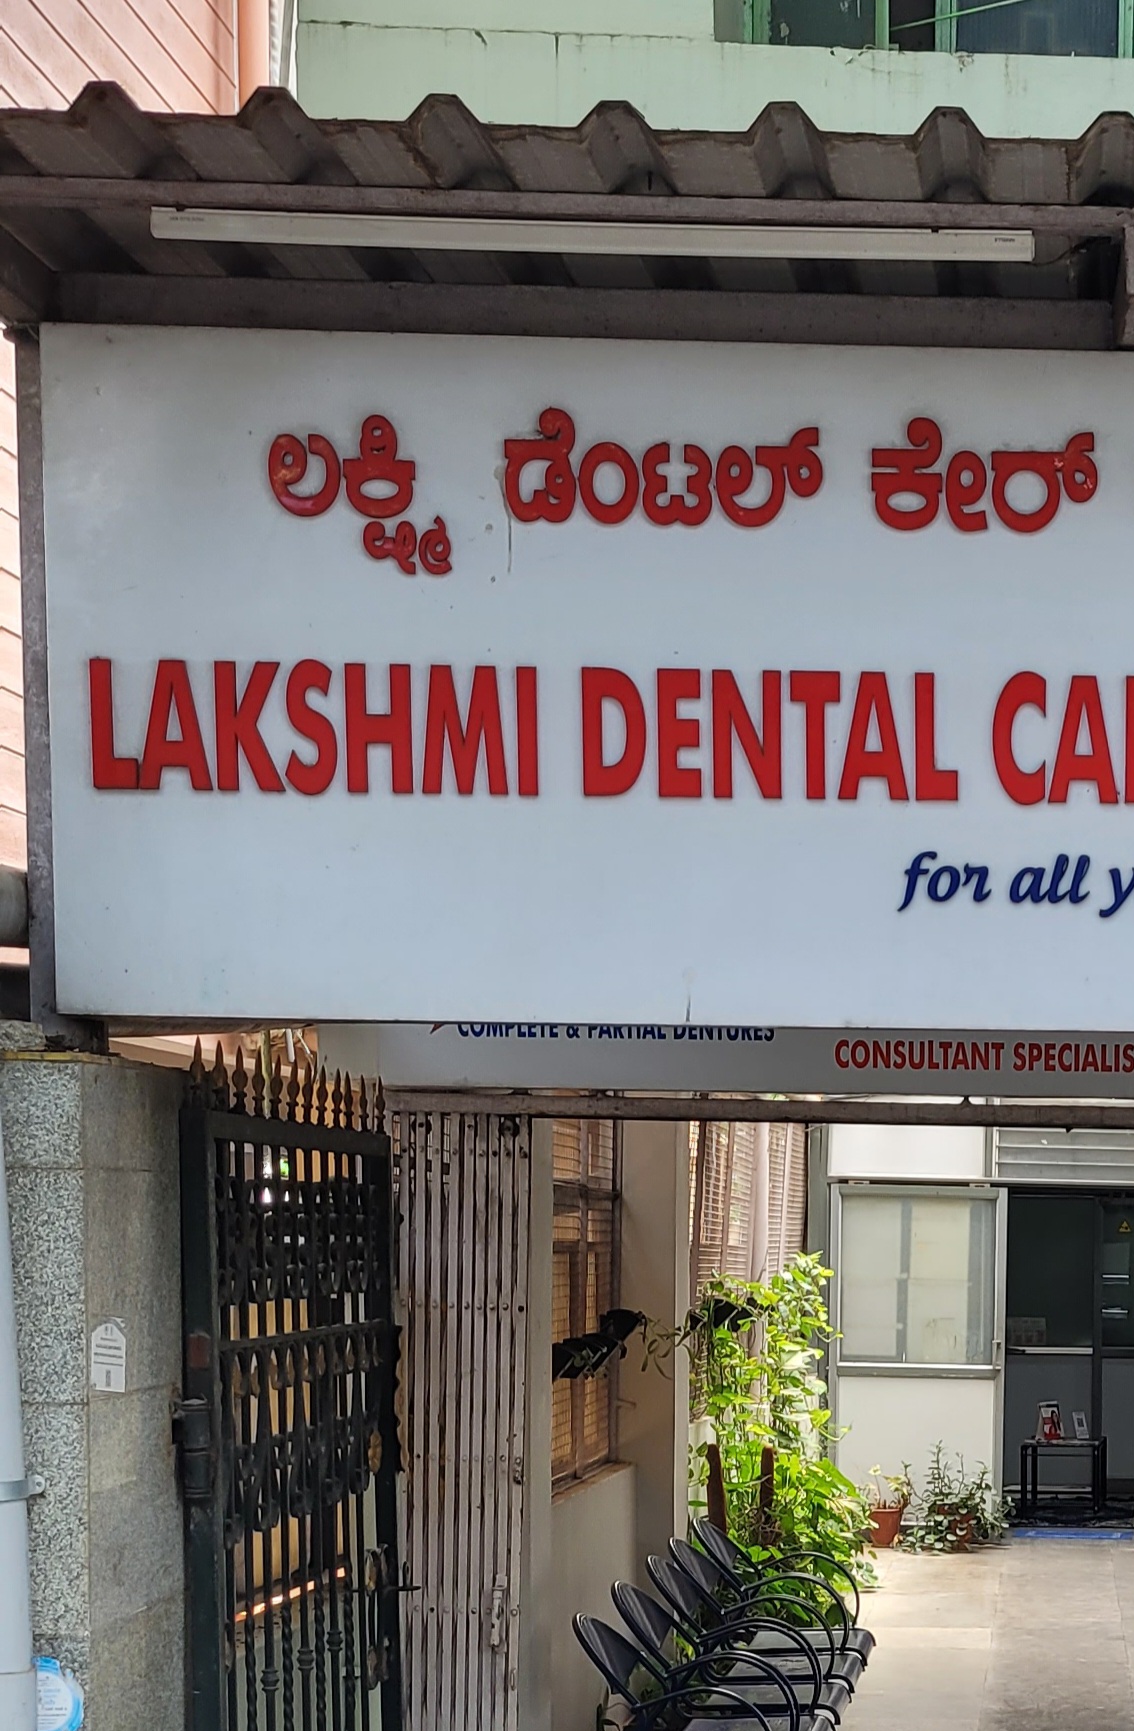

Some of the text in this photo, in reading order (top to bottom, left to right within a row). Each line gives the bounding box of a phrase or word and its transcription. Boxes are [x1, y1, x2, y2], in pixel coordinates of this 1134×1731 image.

[503, 408, 823, 527] ಡೆಂಟಲ್
[871, 418, 1098, 533] ಕೇರ್
[88, 656, 539, 797] LAKSHMI
[581, 666, 959, 802] DENTAL
[897, 850, 992, 912] for
[1009, 853, 1091, 904] all
[834, 1039, 1005, 1070] CONSULTANT
